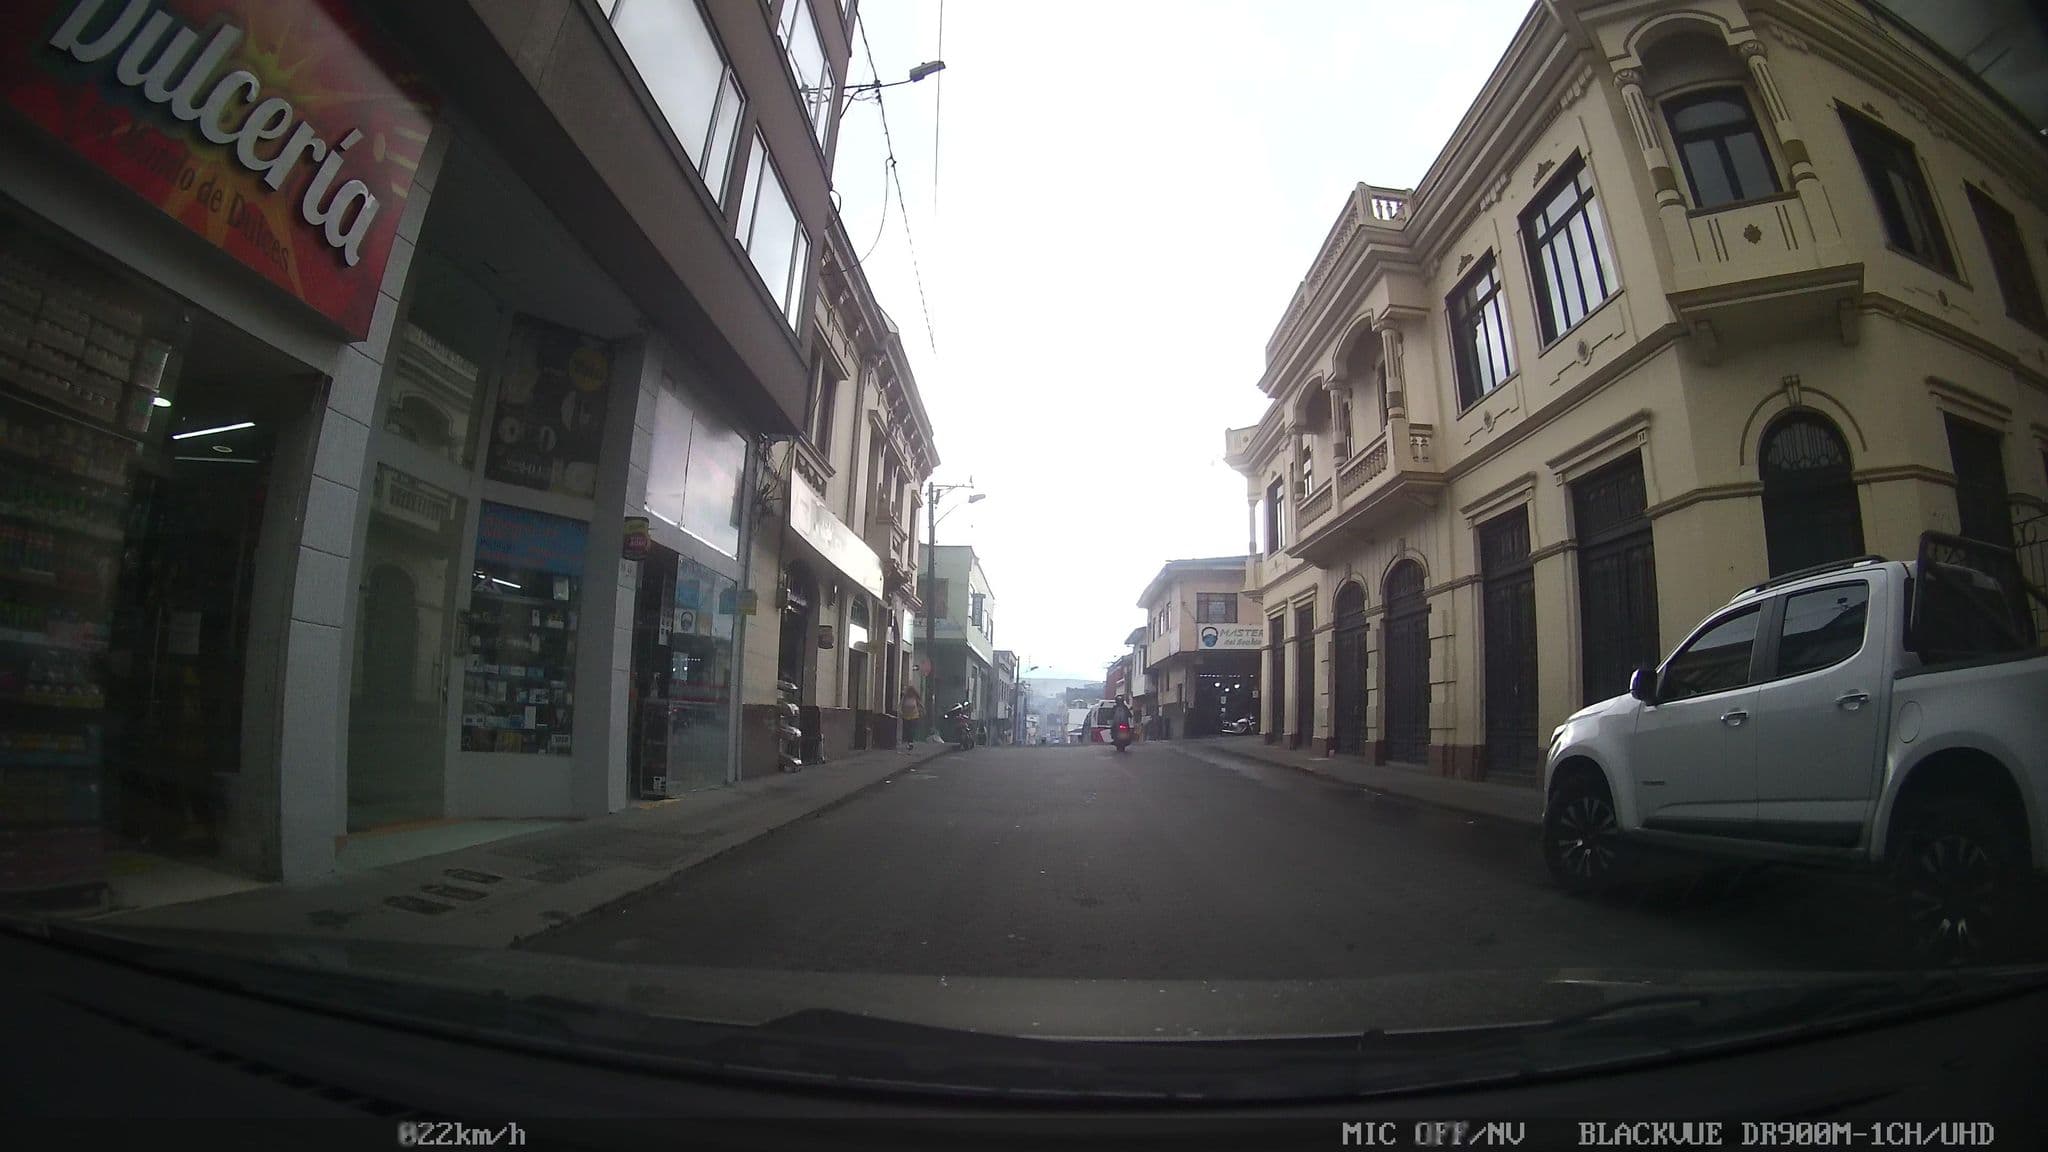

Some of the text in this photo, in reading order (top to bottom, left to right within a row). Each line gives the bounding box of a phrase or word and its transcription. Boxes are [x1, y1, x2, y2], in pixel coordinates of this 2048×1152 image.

[49, 0, 381, 268] Dulcería
[196, 174, 223, 213] de
[227, 191, 291, 273] Dulces
